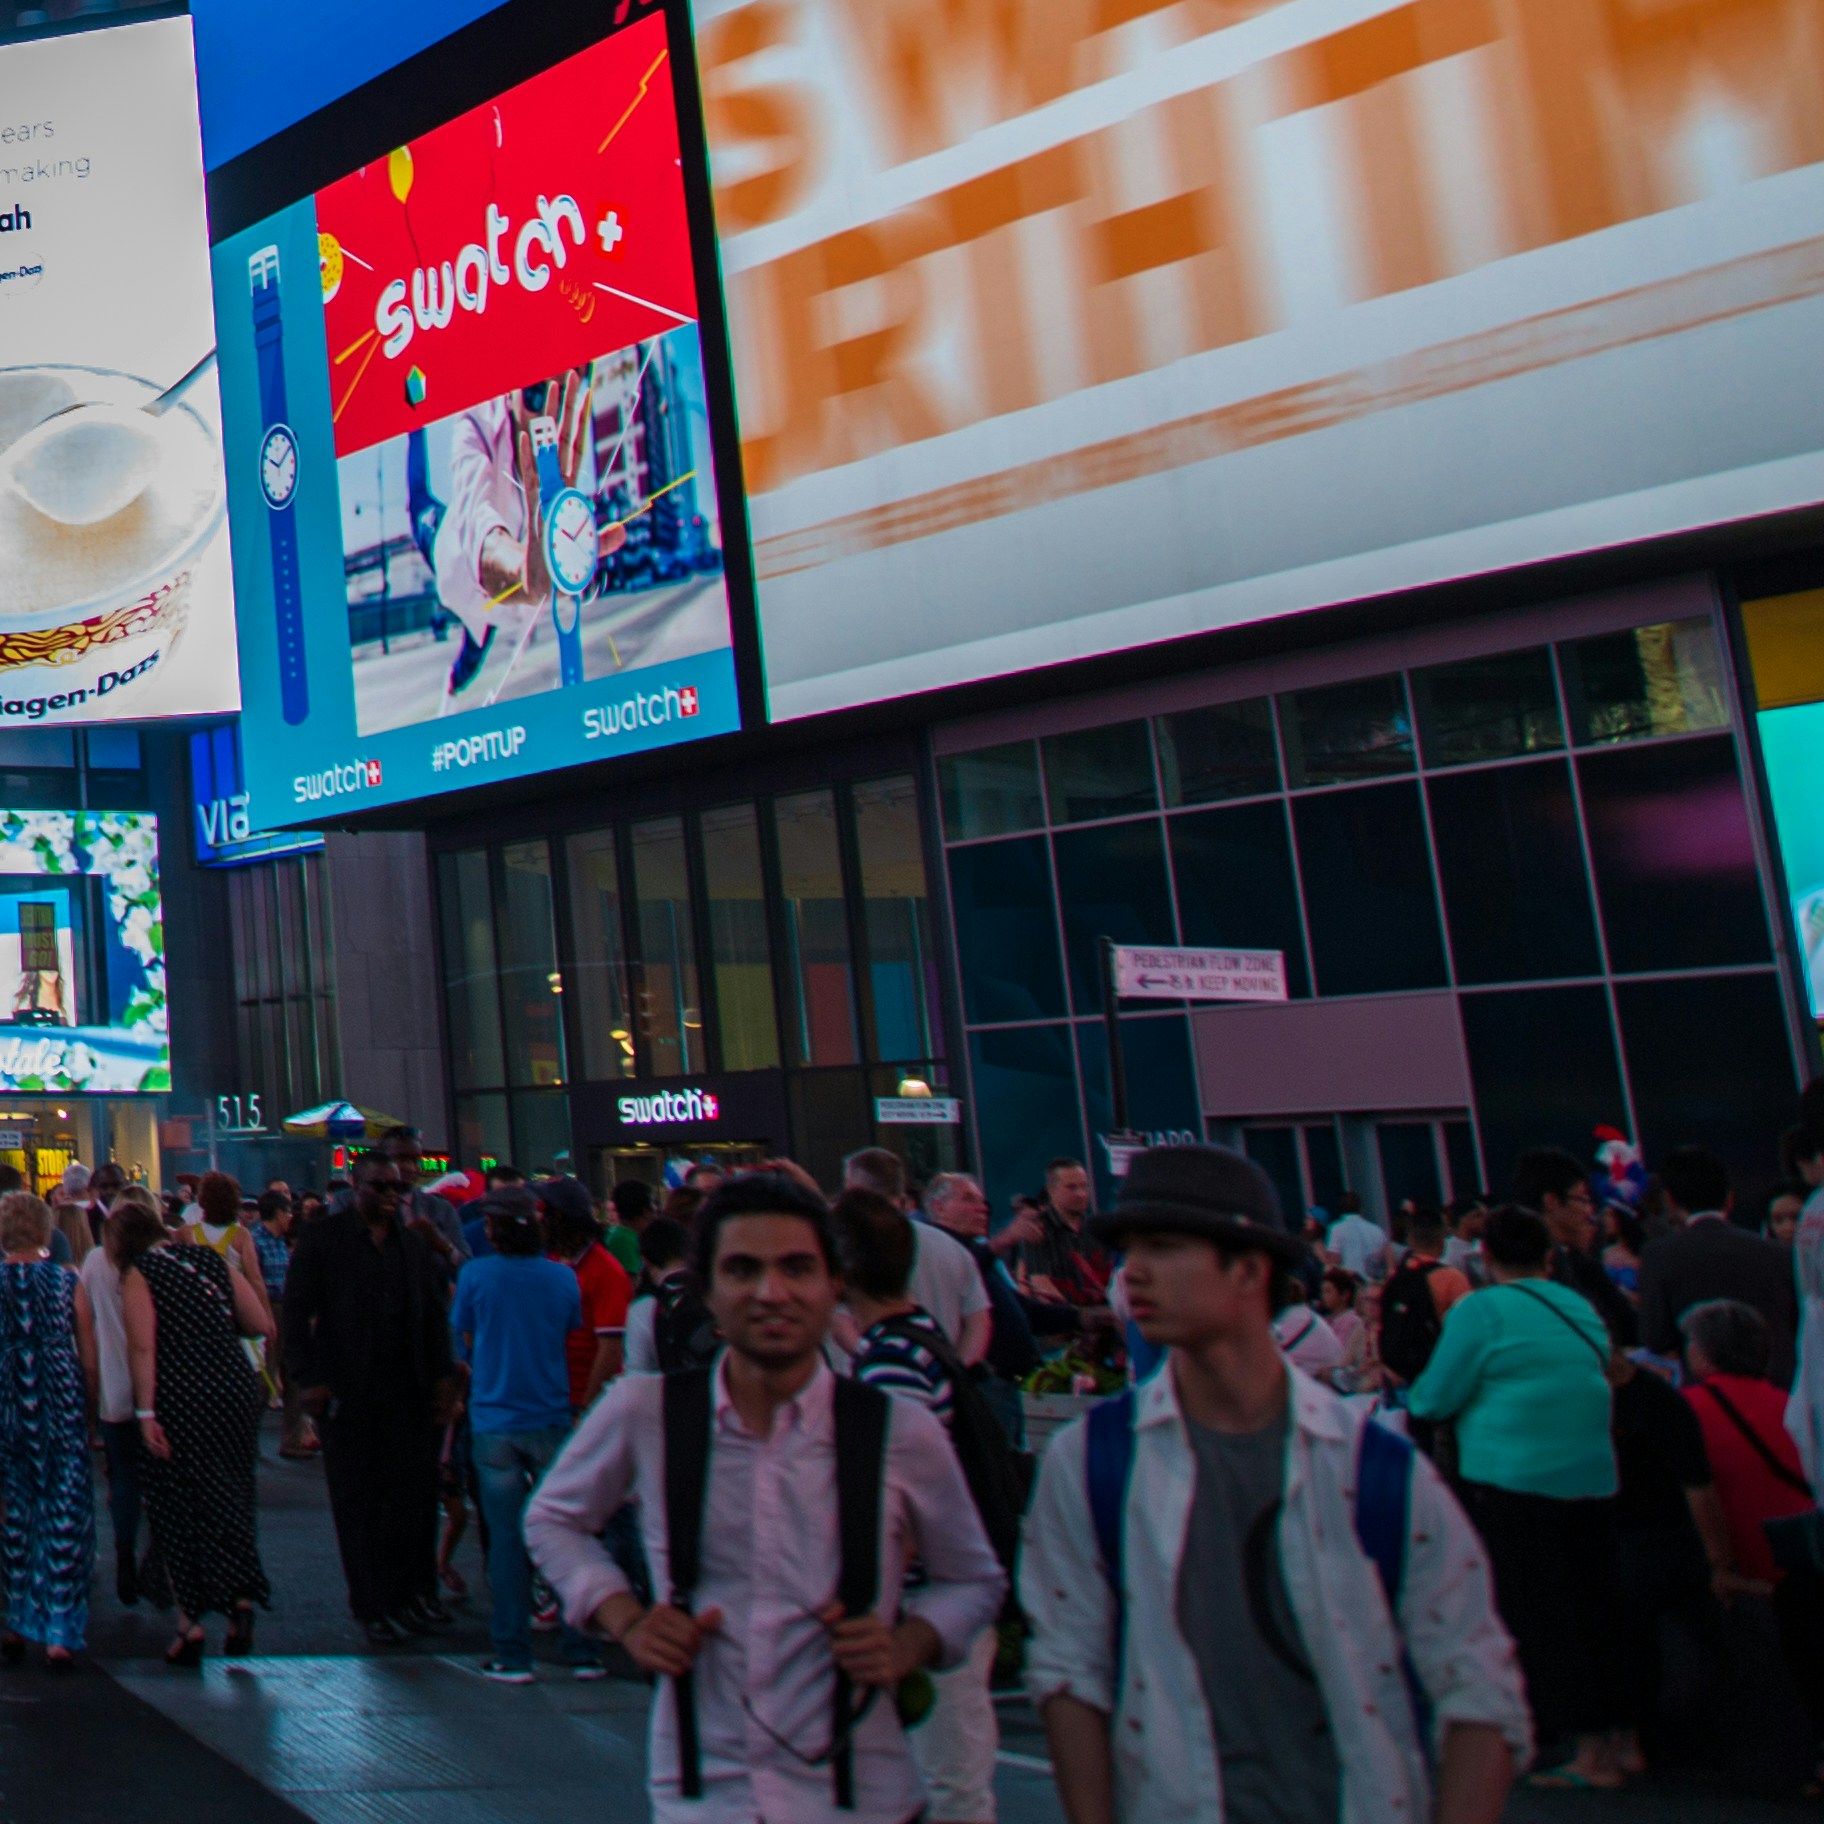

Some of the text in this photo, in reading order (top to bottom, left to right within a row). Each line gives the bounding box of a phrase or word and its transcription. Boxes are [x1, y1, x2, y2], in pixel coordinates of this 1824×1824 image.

[375, 193, 586, 360] swatch
[583, 687, 681, 740] swatch
[431, 726, 527, 773] #POPITUP
[293, 761, 367, 804] swatch
[1133, 953, 1202, 969] PEDESTRIAN
[217, 1096, 260, 1130] 515
[619, 1088, 703, 1123] swatch
